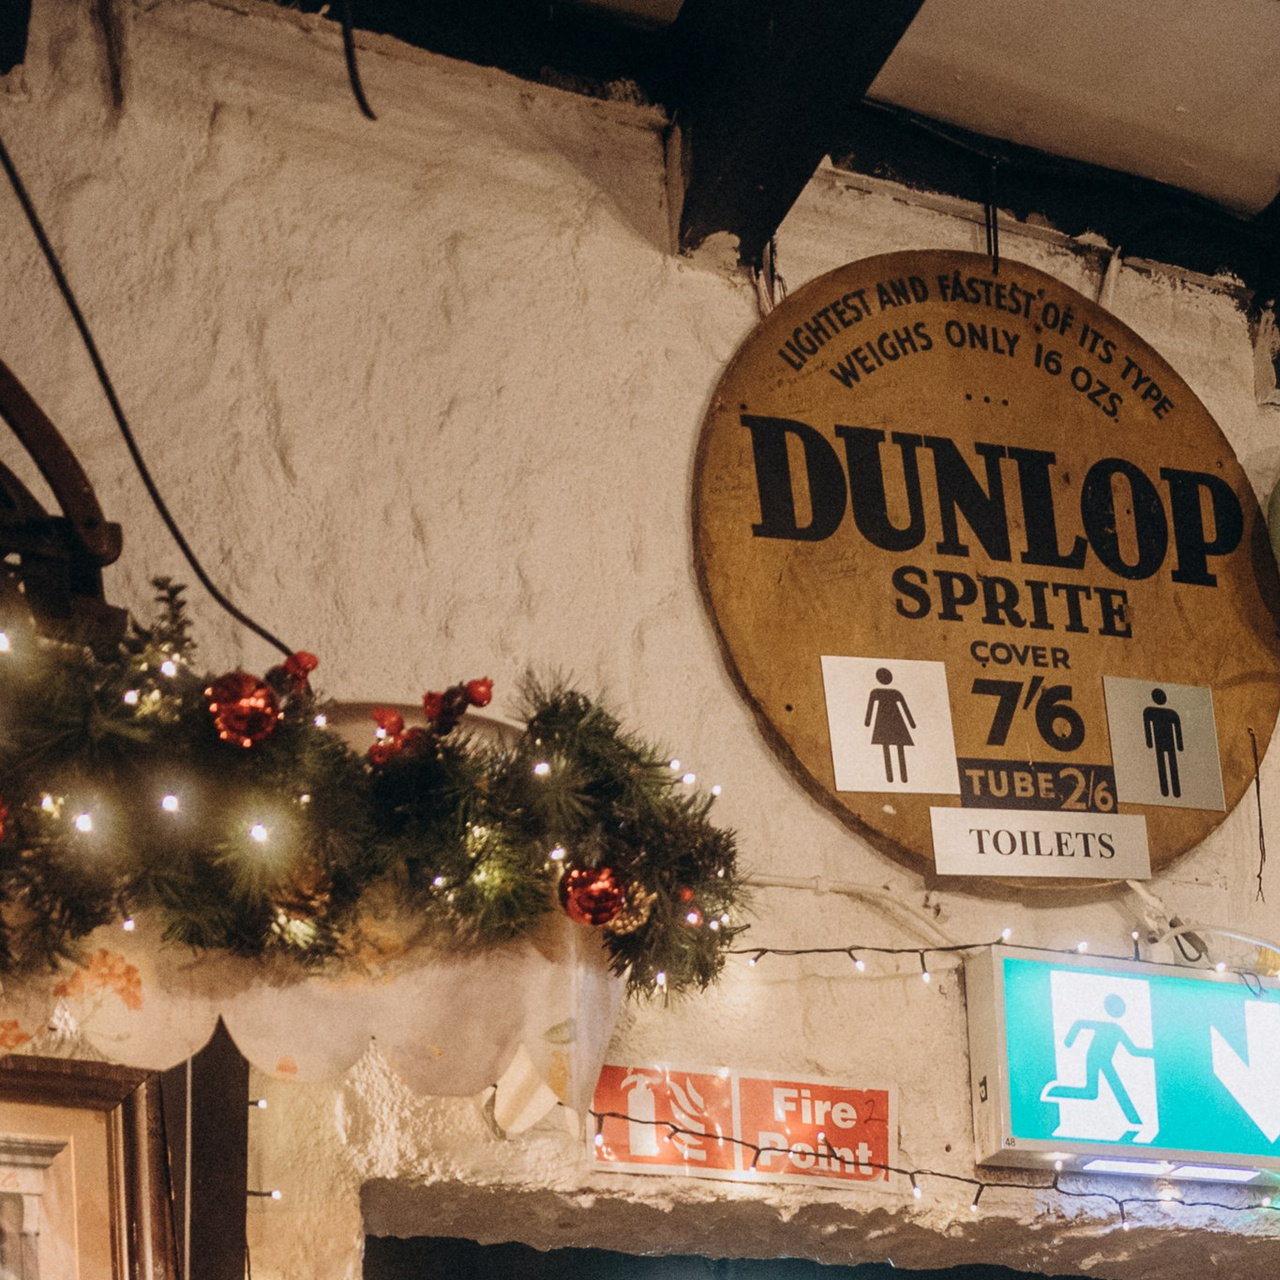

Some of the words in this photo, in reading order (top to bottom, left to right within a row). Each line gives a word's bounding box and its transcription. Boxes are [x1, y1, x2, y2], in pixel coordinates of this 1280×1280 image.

[779, 288, 872, 371] LIGHTEST
[876, 276, 929, 311] AND
[937, 270, 1036, 319] FASTEST
[1041, 302, 1075, 336] OF
[1078, 323, 1117, 364] ITS
[1120, 356, 1175, 420] TYPE
[829, 322, 934, 389] WEIGHS
[944, 319, 1020, 358] ONLY
[1034, 342, 1063, 376] 16
[1070, 365, 1124, 423] OZS.
[740, 413, 1244, 587] DUNLOP
[891, 565, 1133, 639] SPRITE
[970, 640, 1072, 670] COVER
[965, 768, 1056, 800] TUBE
[1059, 767, 1114, 812] 2/6
[969, 828, 1116, 860] TOILETS
[773, 1087, 857, 1128] Fire
[758, 1131, 873, 1176] Point
